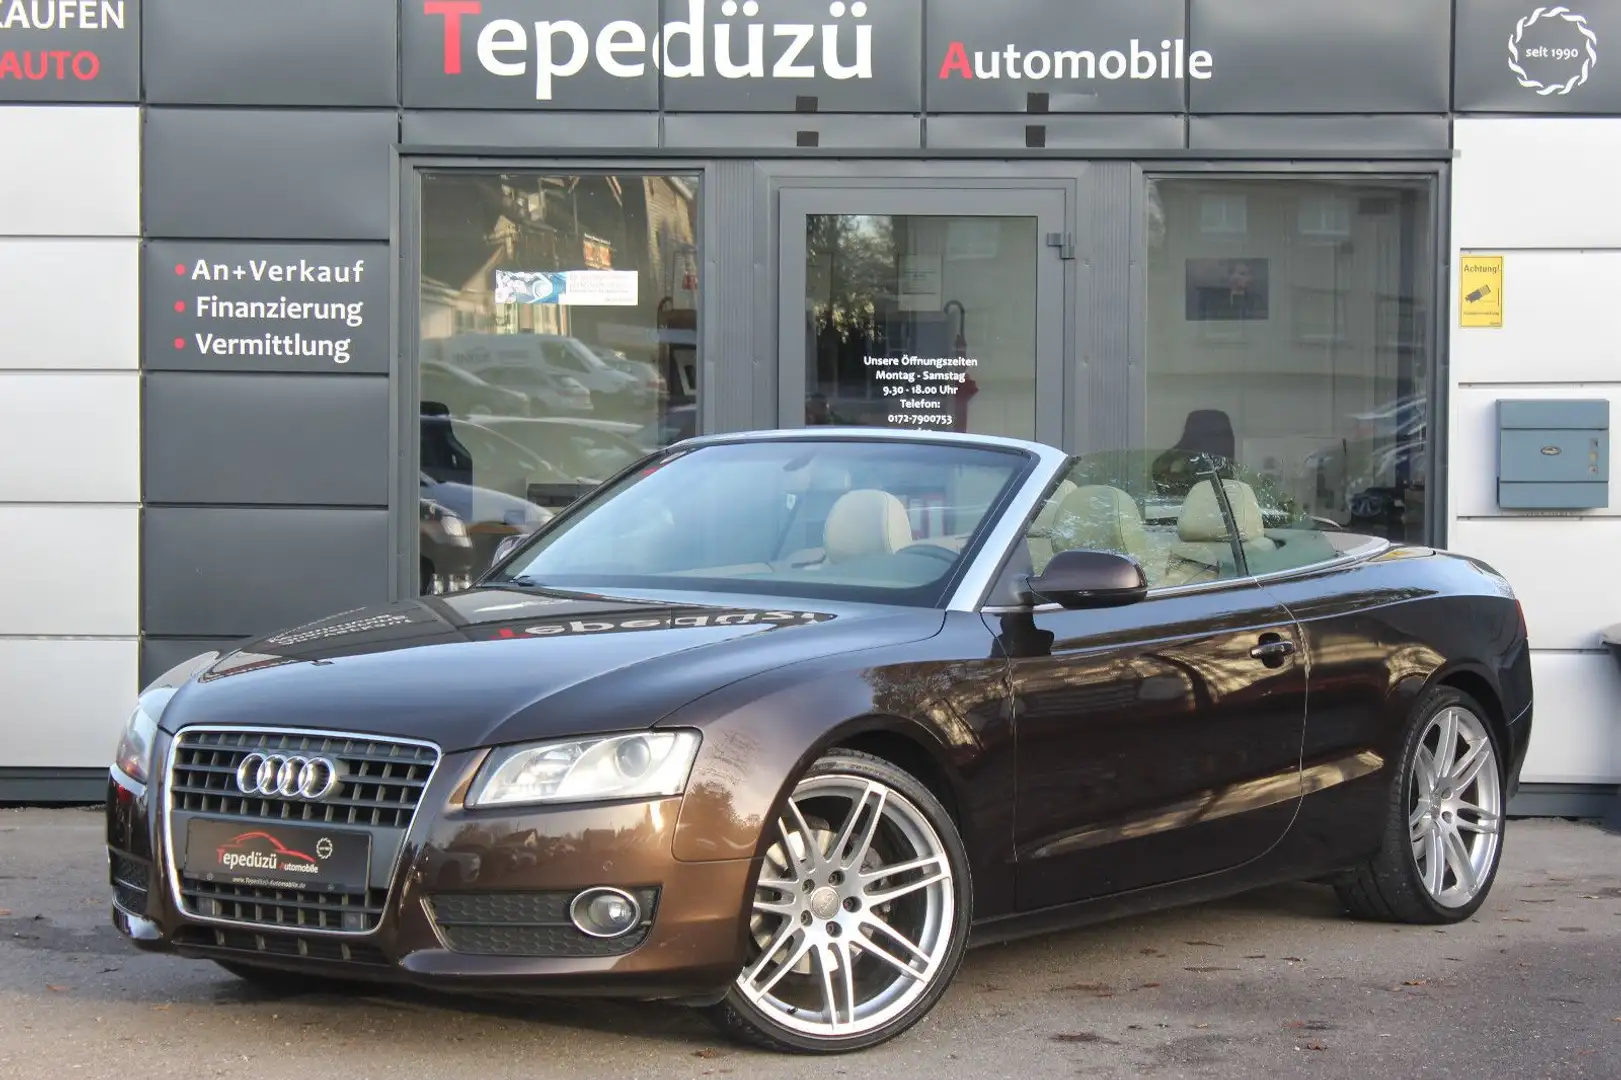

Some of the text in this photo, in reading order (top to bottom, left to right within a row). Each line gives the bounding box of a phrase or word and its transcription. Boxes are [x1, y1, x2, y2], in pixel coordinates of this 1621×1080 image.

[0, 0, 125, 29] AUFEN
[424, 0, 1213, 100] Tepedüzü Automobile
[1525, 46, 1579, 60] seit 1990
[0, 50, 100, 80] AUTO
[191, 259, 365, 283] An+Verkauf
[1463, 264, 1500, 274] Achtung!
[196, 296, 363, 326] Finanzierung
[195, 333, 351, 363] Vermittlung
[863, 354, 978, 368] Unsere Öffnungszeiten
[875, 370, 915, 382] Montag
[923, 371, 966, 383] Samstag
[882, 386, 904, 396] 9.30
[911, 385, 937, 395] 18.00
[939, 385, 959, 395] Uhr
[900, 399, 941, 409] Telefon:
[888, 414, 953, 425] 0172-7900753
[217, 848, 319, 874] Tepedüzü Automobile
